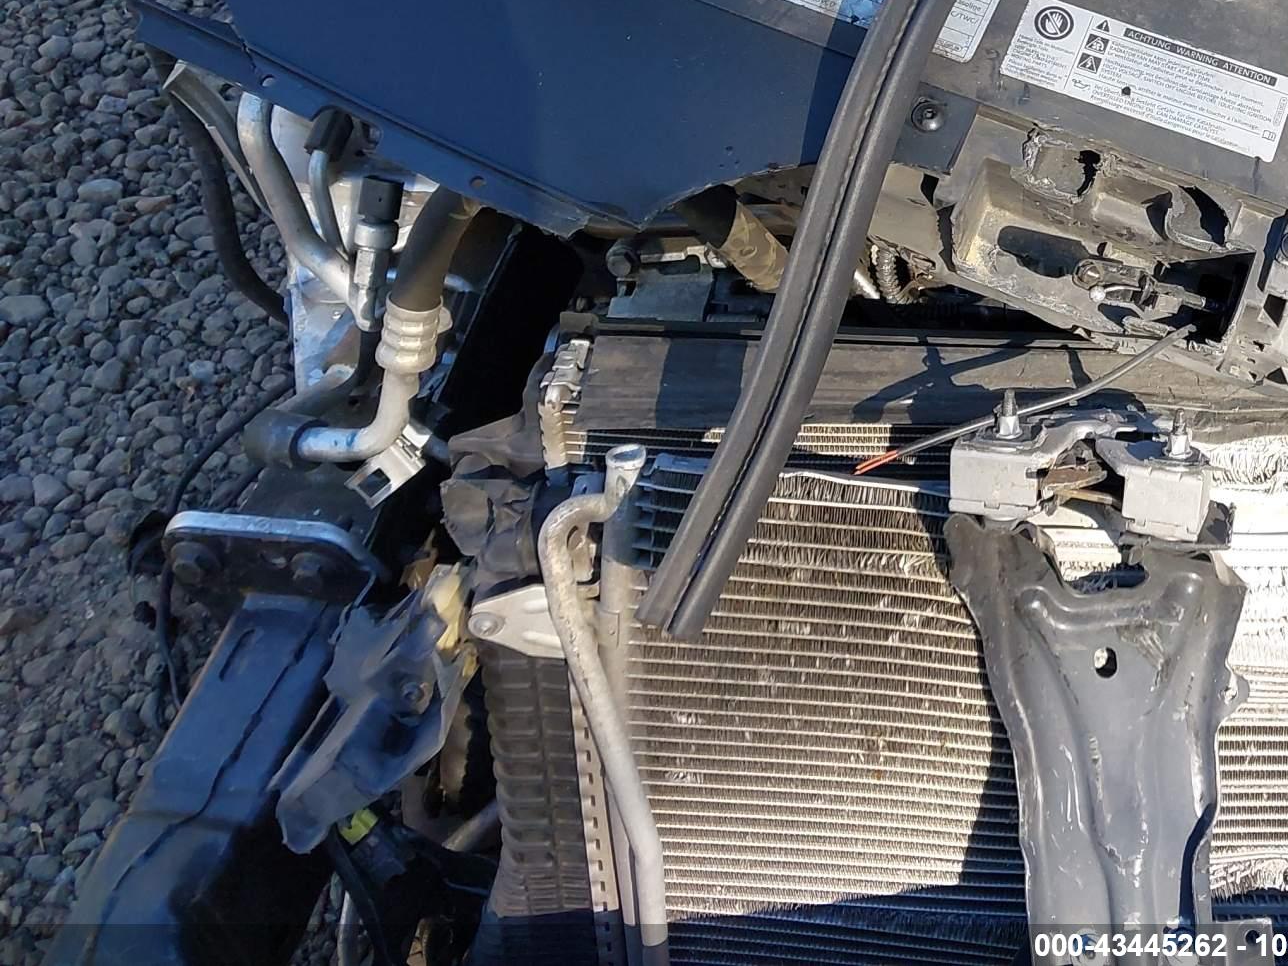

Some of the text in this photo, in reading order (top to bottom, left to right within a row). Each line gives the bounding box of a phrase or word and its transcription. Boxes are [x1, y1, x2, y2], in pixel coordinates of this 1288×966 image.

[1127, 29, 1271, 83] ACHTUNG WARNING ATTENTION
